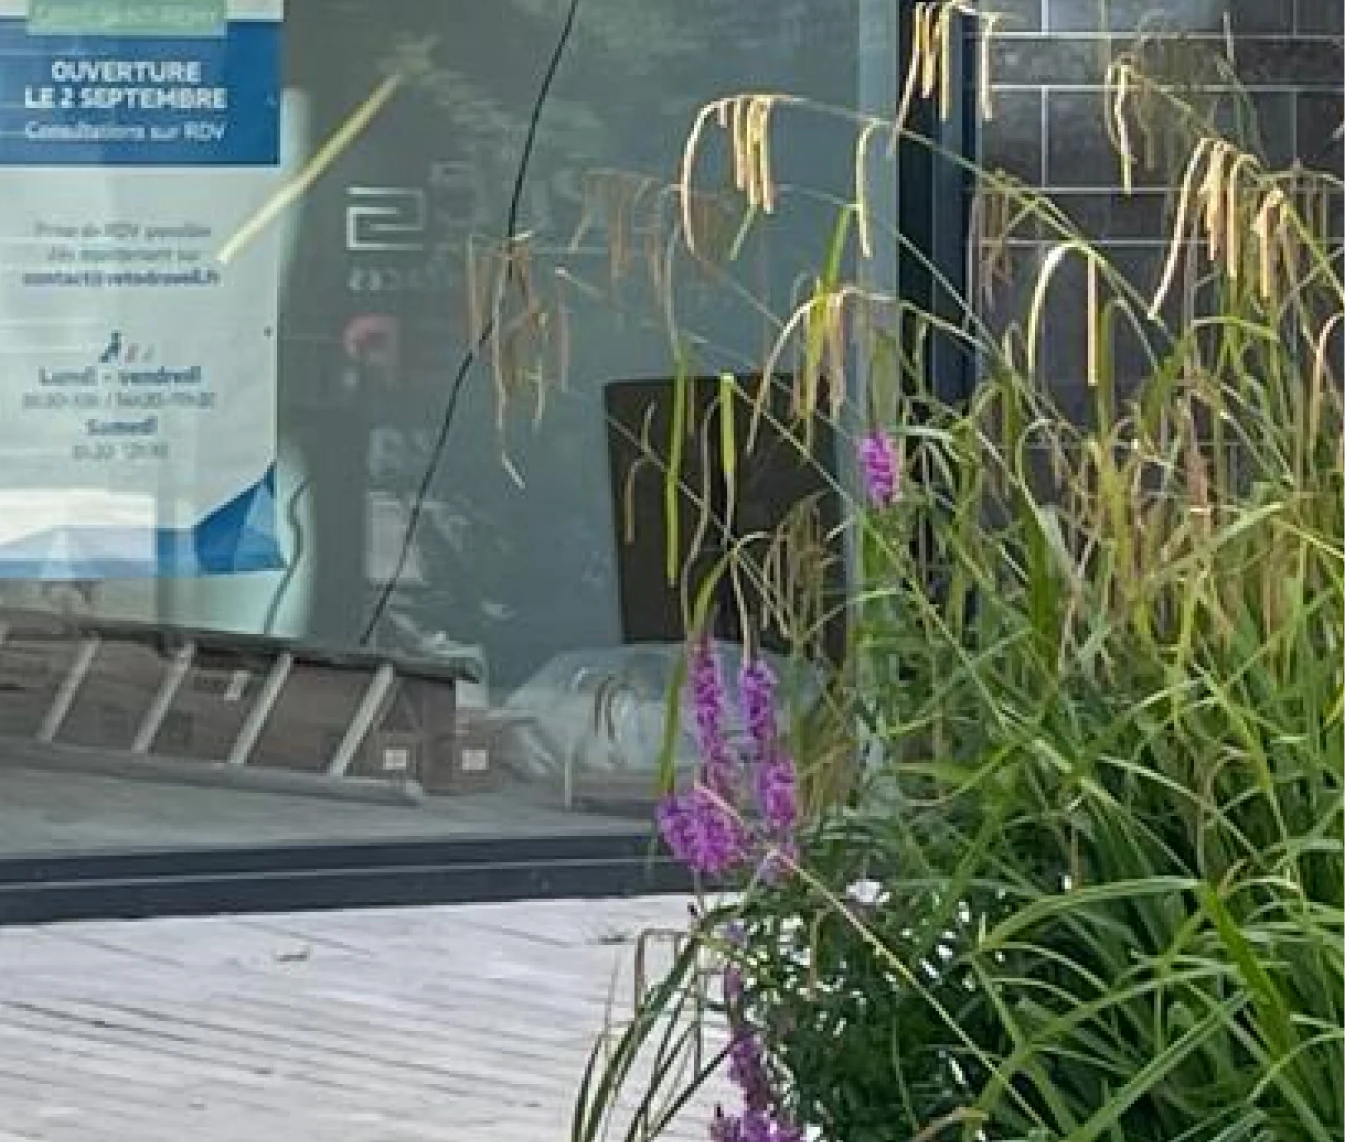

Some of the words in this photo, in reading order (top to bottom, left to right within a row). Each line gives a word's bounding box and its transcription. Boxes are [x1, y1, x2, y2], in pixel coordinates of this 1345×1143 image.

[51, 60, 202, 83] OUVERTURE
[24, 86, 55, 109] LE
[60, 87, 75, 109] 2
[80, 87, 228, 110] SEPTEMBRE
[183, 122, 227, 141] RDV
